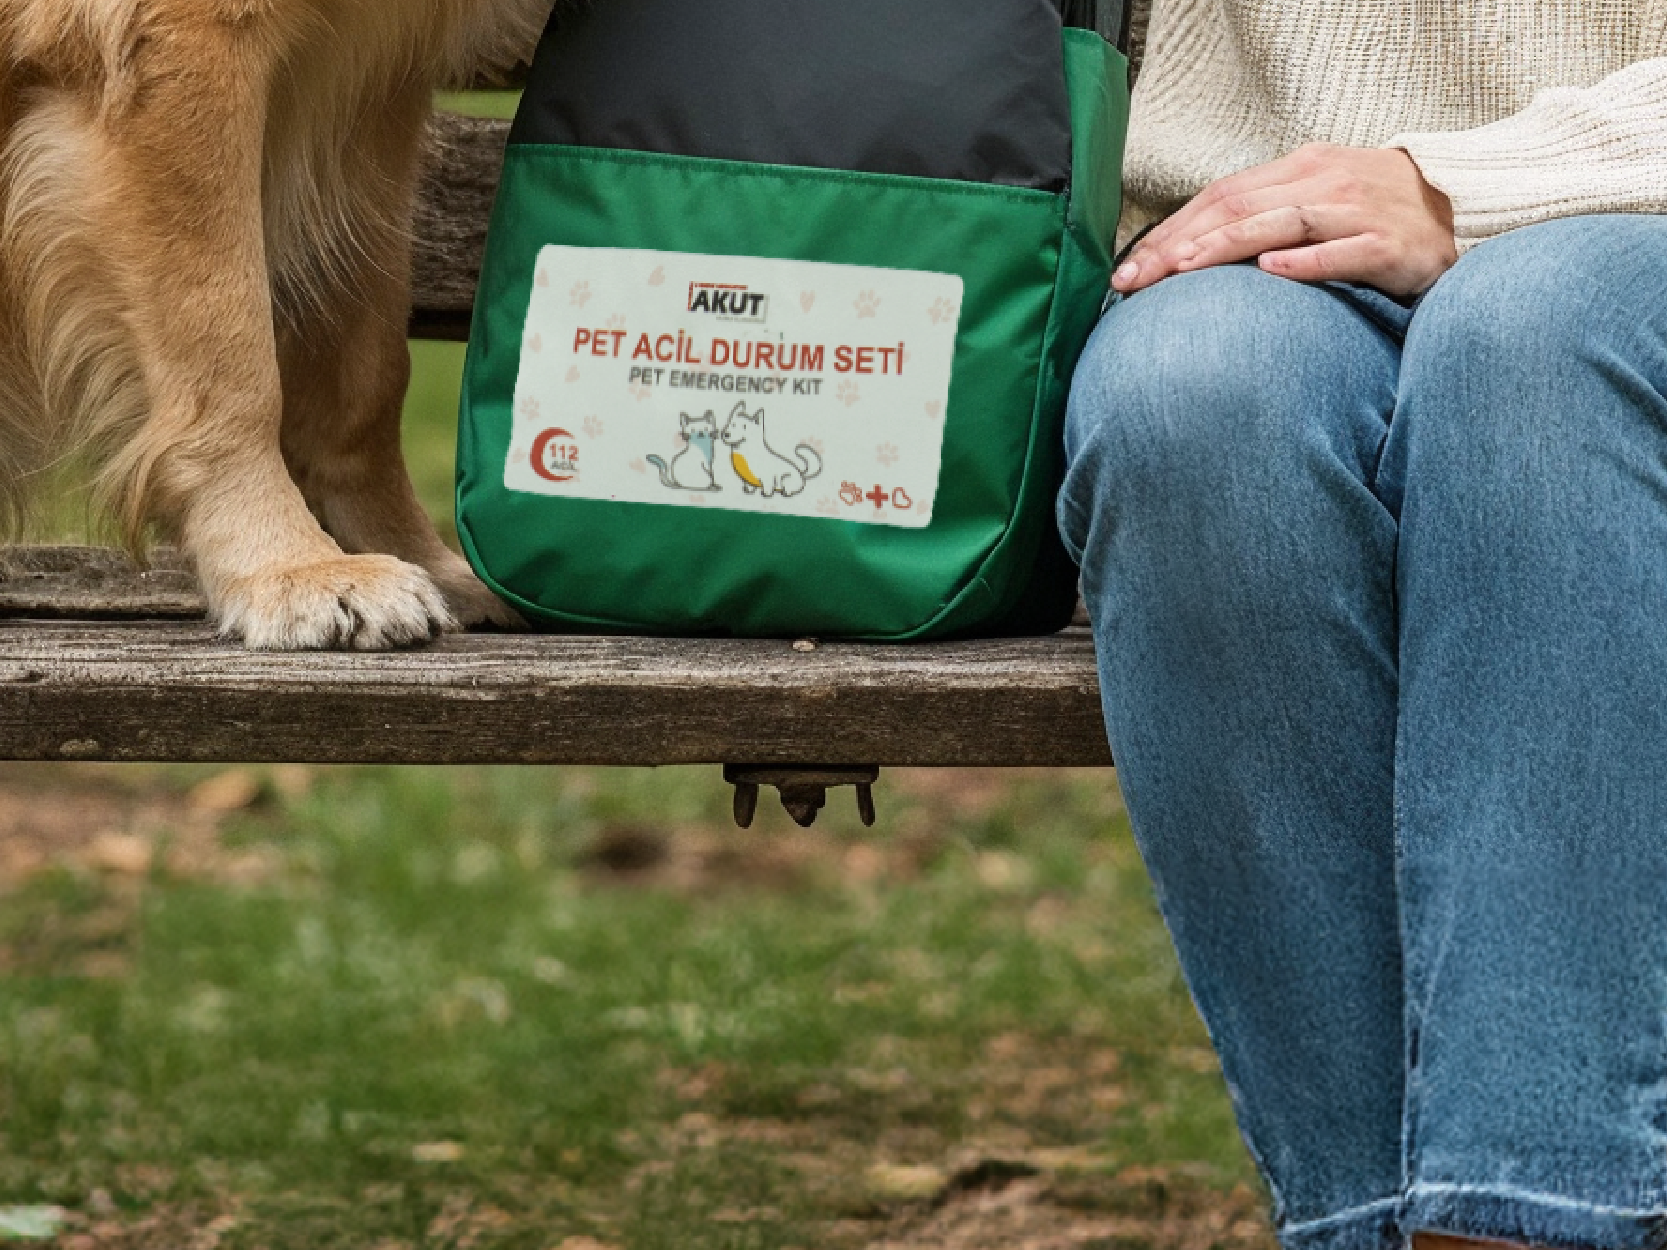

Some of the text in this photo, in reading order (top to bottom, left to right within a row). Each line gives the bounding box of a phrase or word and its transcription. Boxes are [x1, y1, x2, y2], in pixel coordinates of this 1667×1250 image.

[690, 289, 764, 316] AKUT
[573, 327, 905, 376] PET ACİL DURUM SETİ
[628, 366, 665, 385] PET
[669, 369, 788, 394] EMERGENCY
[549, 443, 579, 461] 112
